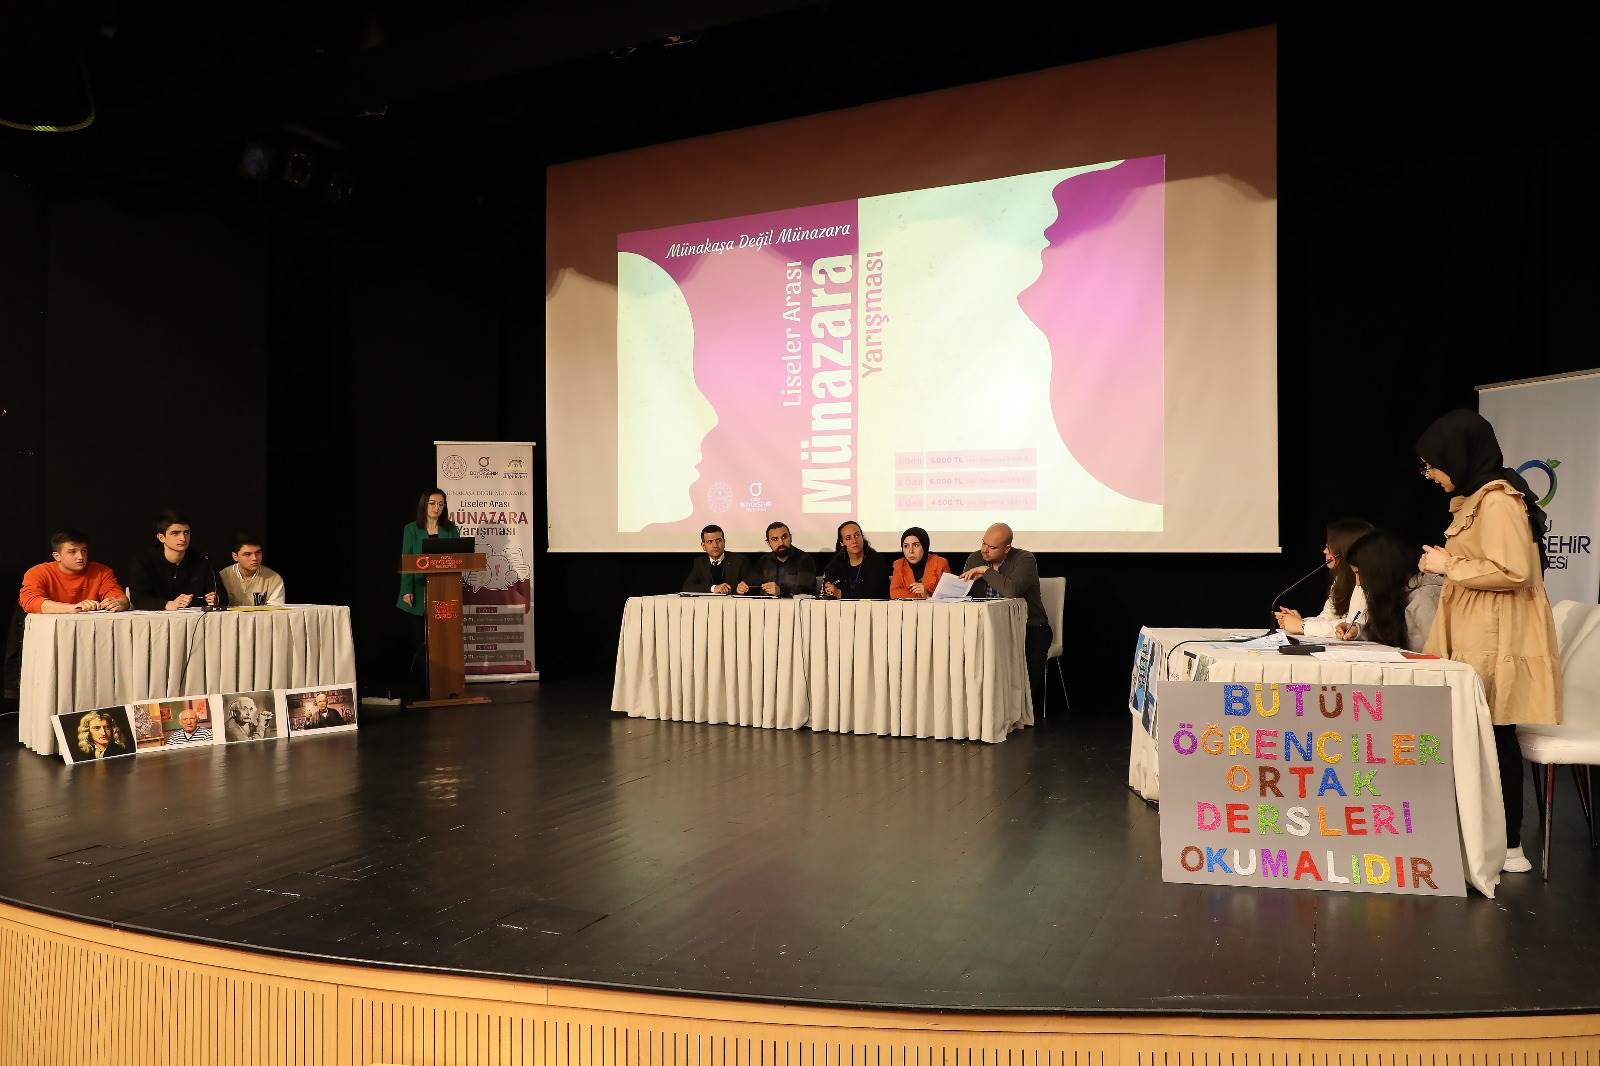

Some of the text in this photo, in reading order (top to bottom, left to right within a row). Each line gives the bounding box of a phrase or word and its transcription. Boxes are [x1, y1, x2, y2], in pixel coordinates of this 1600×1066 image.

[665, 224, 851, 259] Münakaşa Değil Münazara
[781, 260, 802, 407] Liseler Arası
[862, 250, 889, 378] Yarışması
[801, 254, 853, 514] Münazara
[460, 499, 510, 508] Liseler Arası
[1223, 683, 1384, 721] BÜTÜN
[1227, 763, 1381, 799] ORTAK
[1180, 845, 1439, 890] OKUMALIDIR
